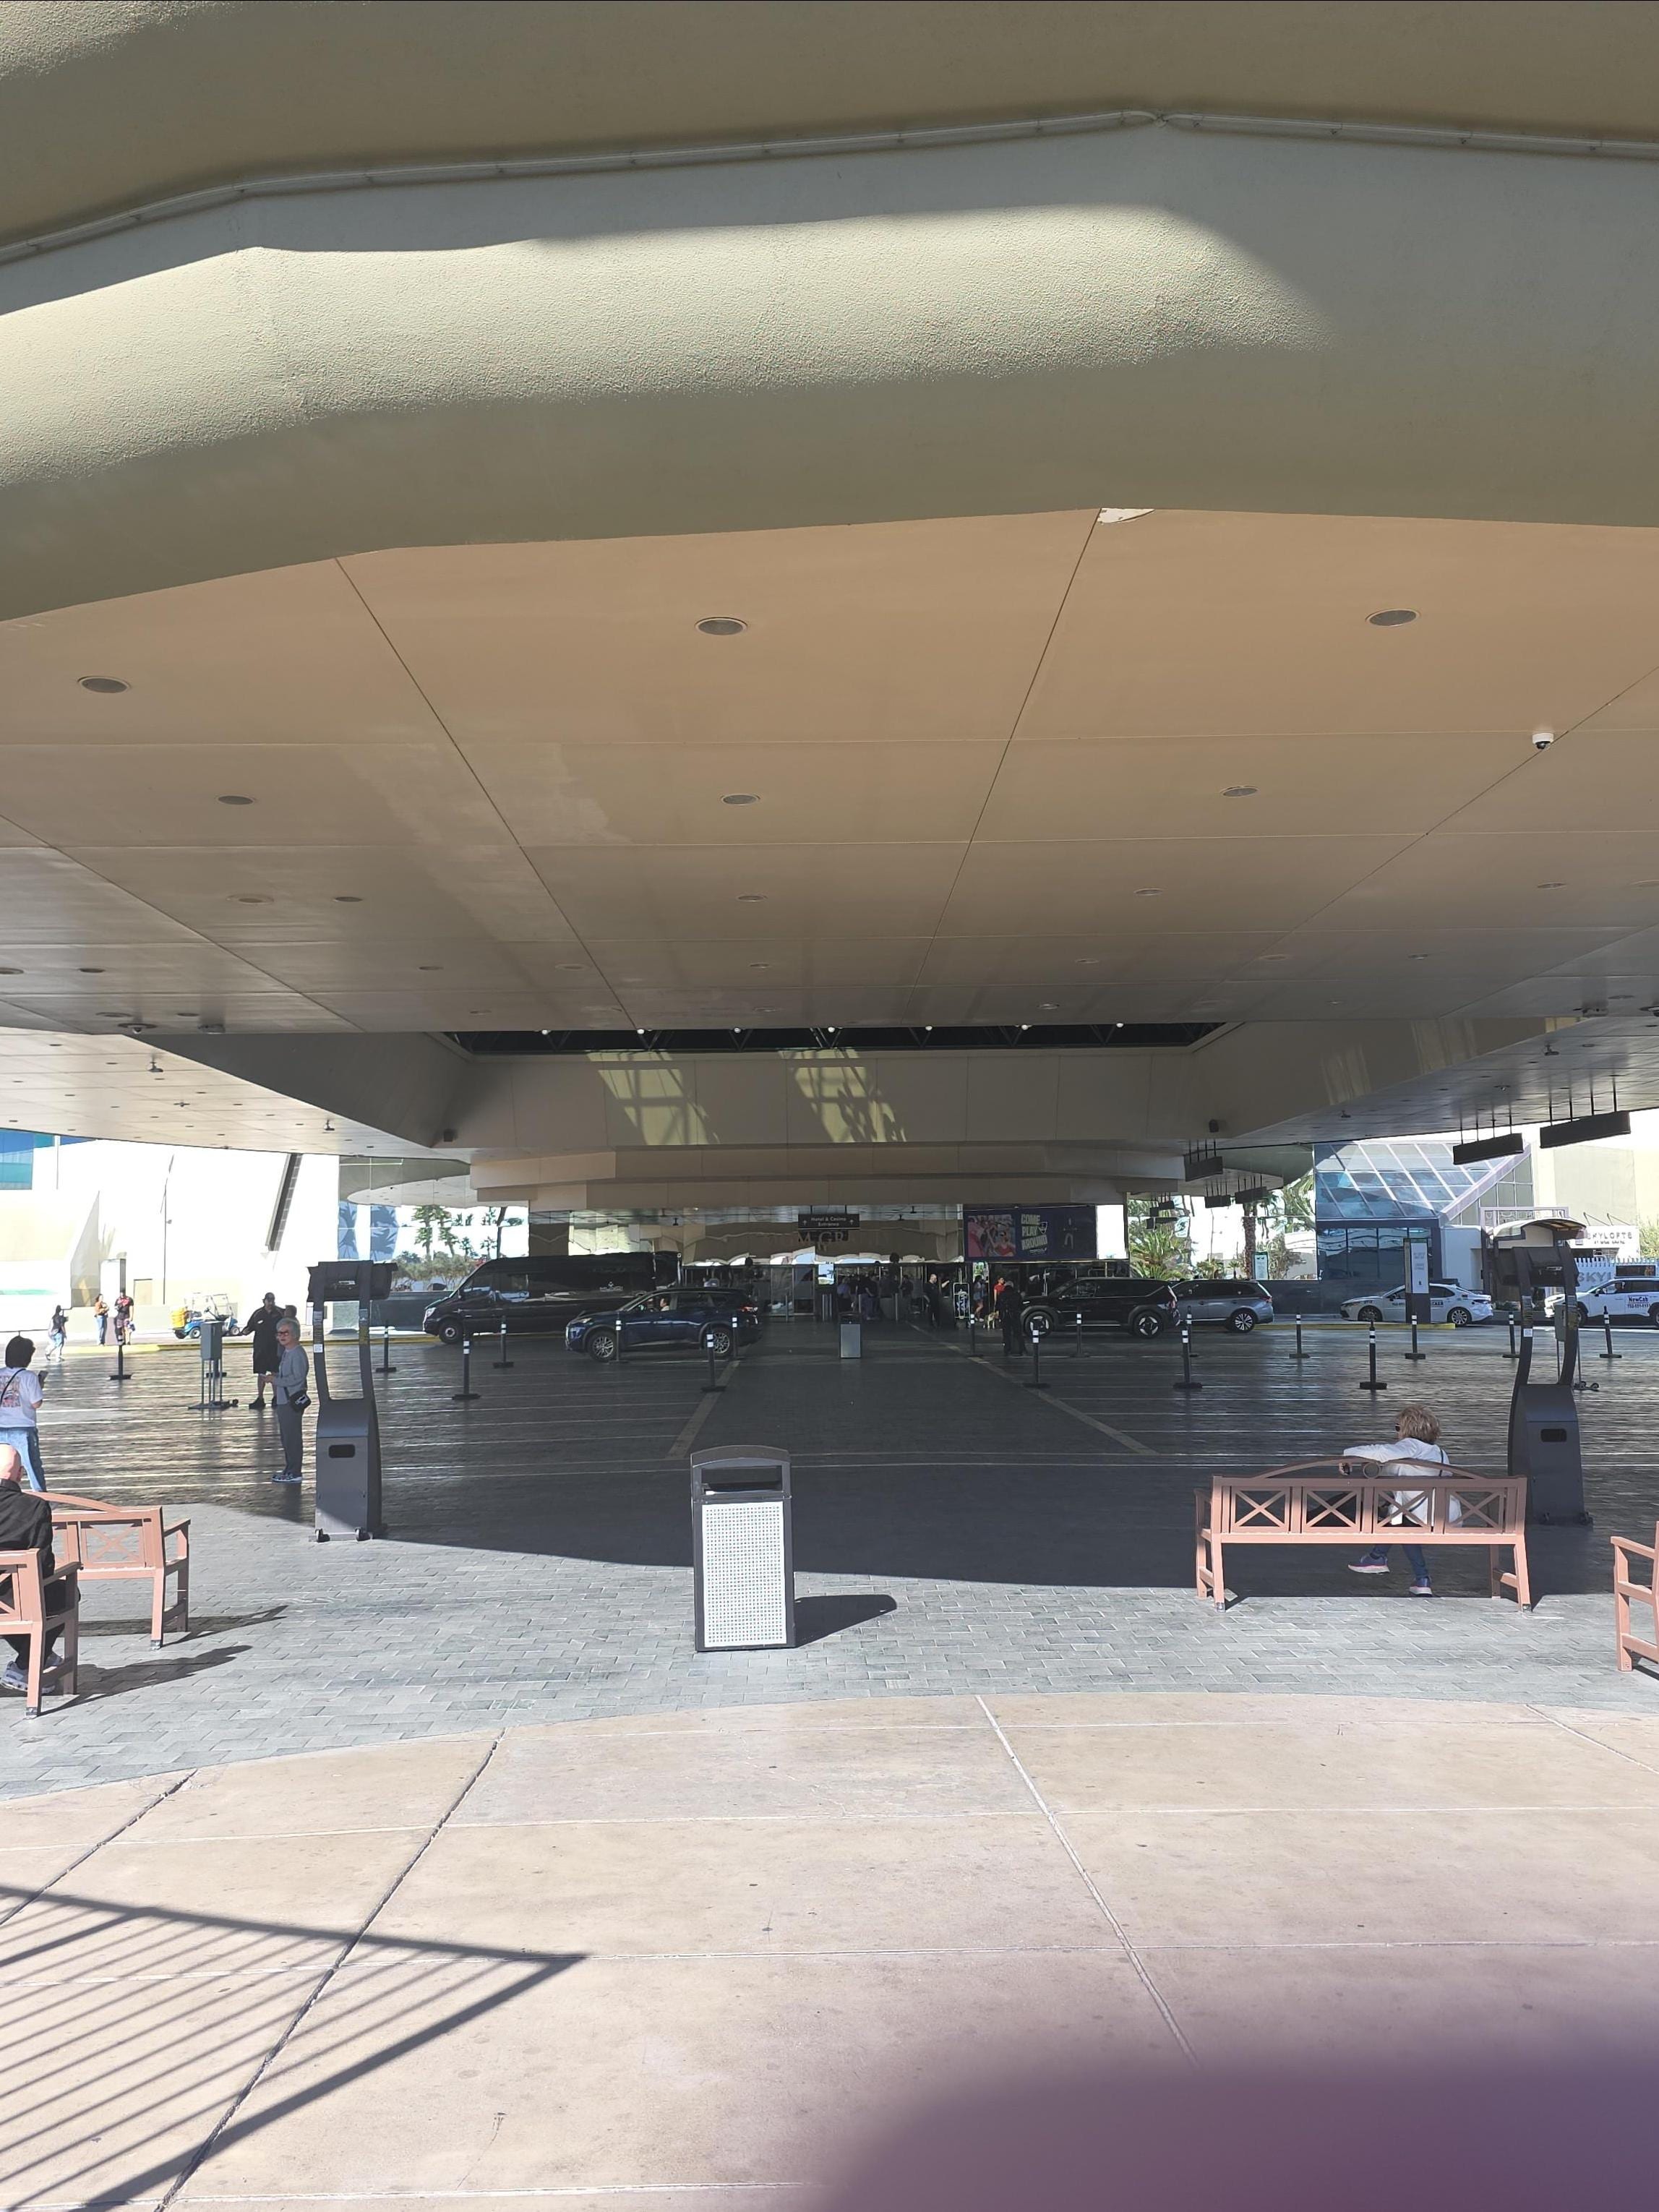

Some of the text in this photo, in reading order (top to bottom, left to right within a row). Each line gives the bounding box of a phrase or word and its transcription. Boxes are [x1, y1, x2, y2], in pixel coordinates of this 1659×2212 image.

[1021, 1214, 1041, 1225] COME
[1021, 1225, 1038, 1237] PLAY
[1021, 1235, 1047, 1251] AROUND
